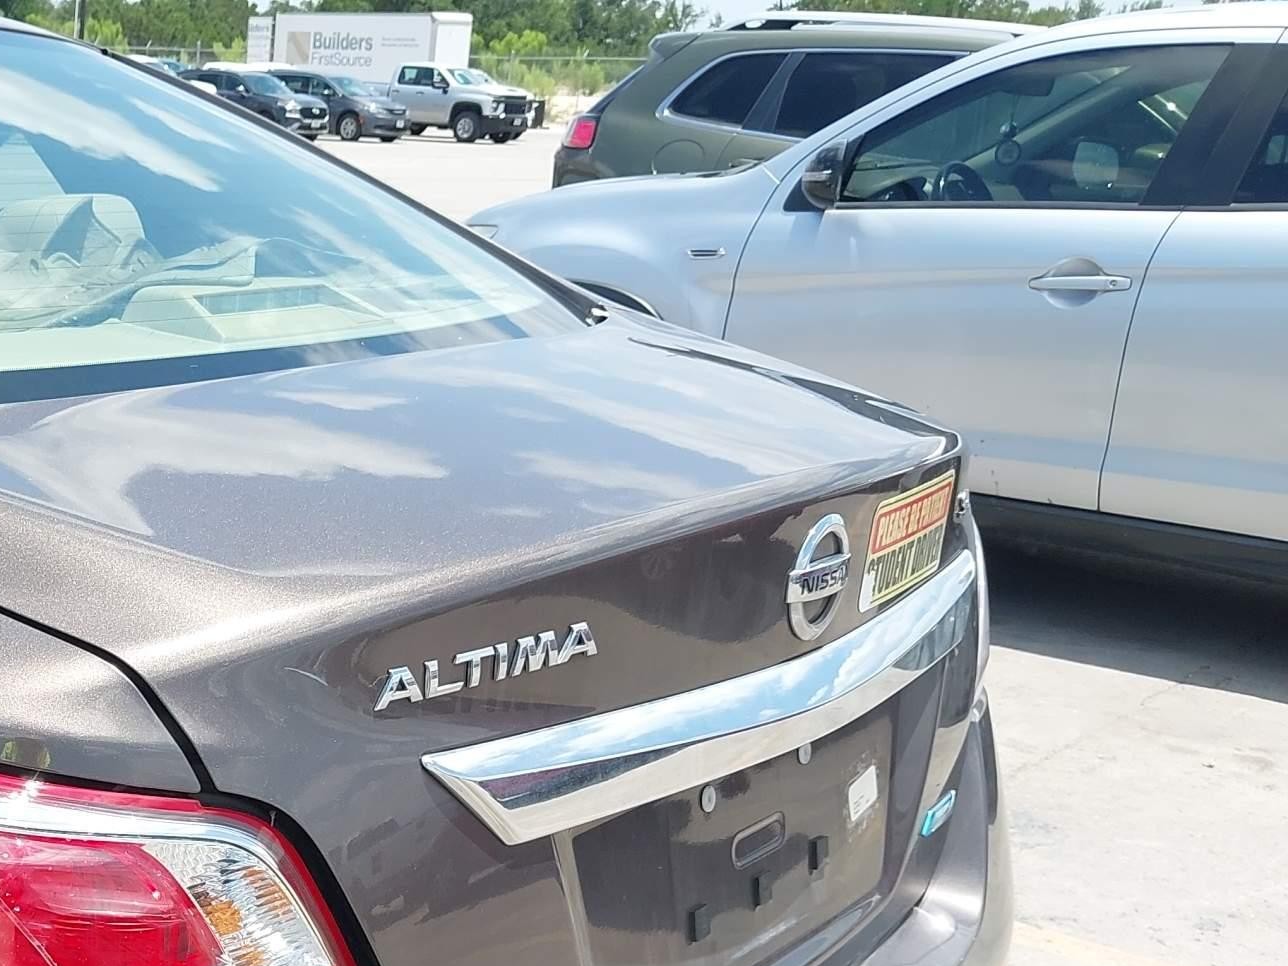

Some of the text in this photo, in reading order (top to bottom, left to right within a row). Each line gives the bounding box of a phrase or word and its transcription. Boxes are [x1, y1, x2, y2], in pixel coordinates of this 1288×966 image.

[312, 32, 373, 51] Builders
[875, 504, 911, 548] PLEASE
[373, 621, 599, 712] ALTIMA
